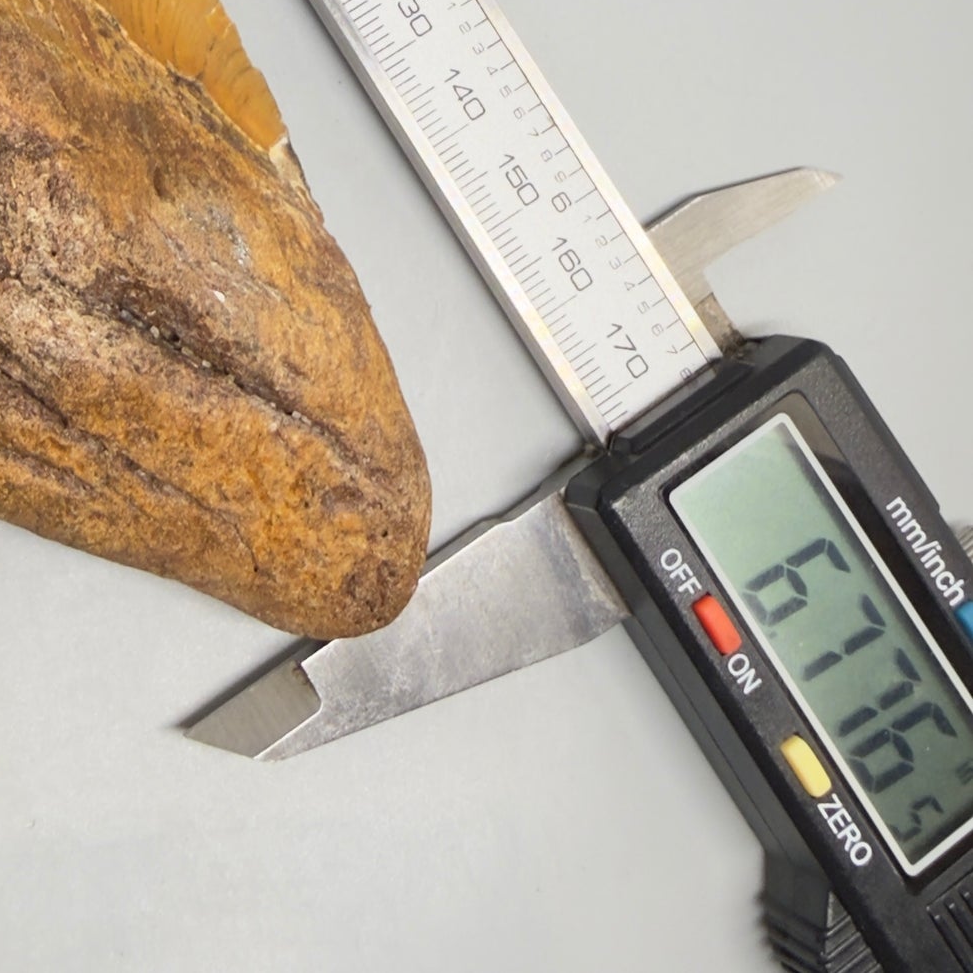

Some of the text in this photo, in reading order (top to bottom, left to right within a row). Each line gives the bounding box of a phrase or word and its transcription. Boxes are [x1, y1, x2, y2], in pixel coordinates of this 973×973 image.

[444, 69, 486, 121] 140
[499, 154, 540, 206] 150
[552, 237, 593, 292] 160
[607, 323, 649, 379] 170
[551, 191, 572, 213] 6
[660, 548, 702, 594] OFF
[885, 496, 965, 607] mm/inch
[727, 653, 762, 695] ON
[817, 793, 873, 867] ZERO
